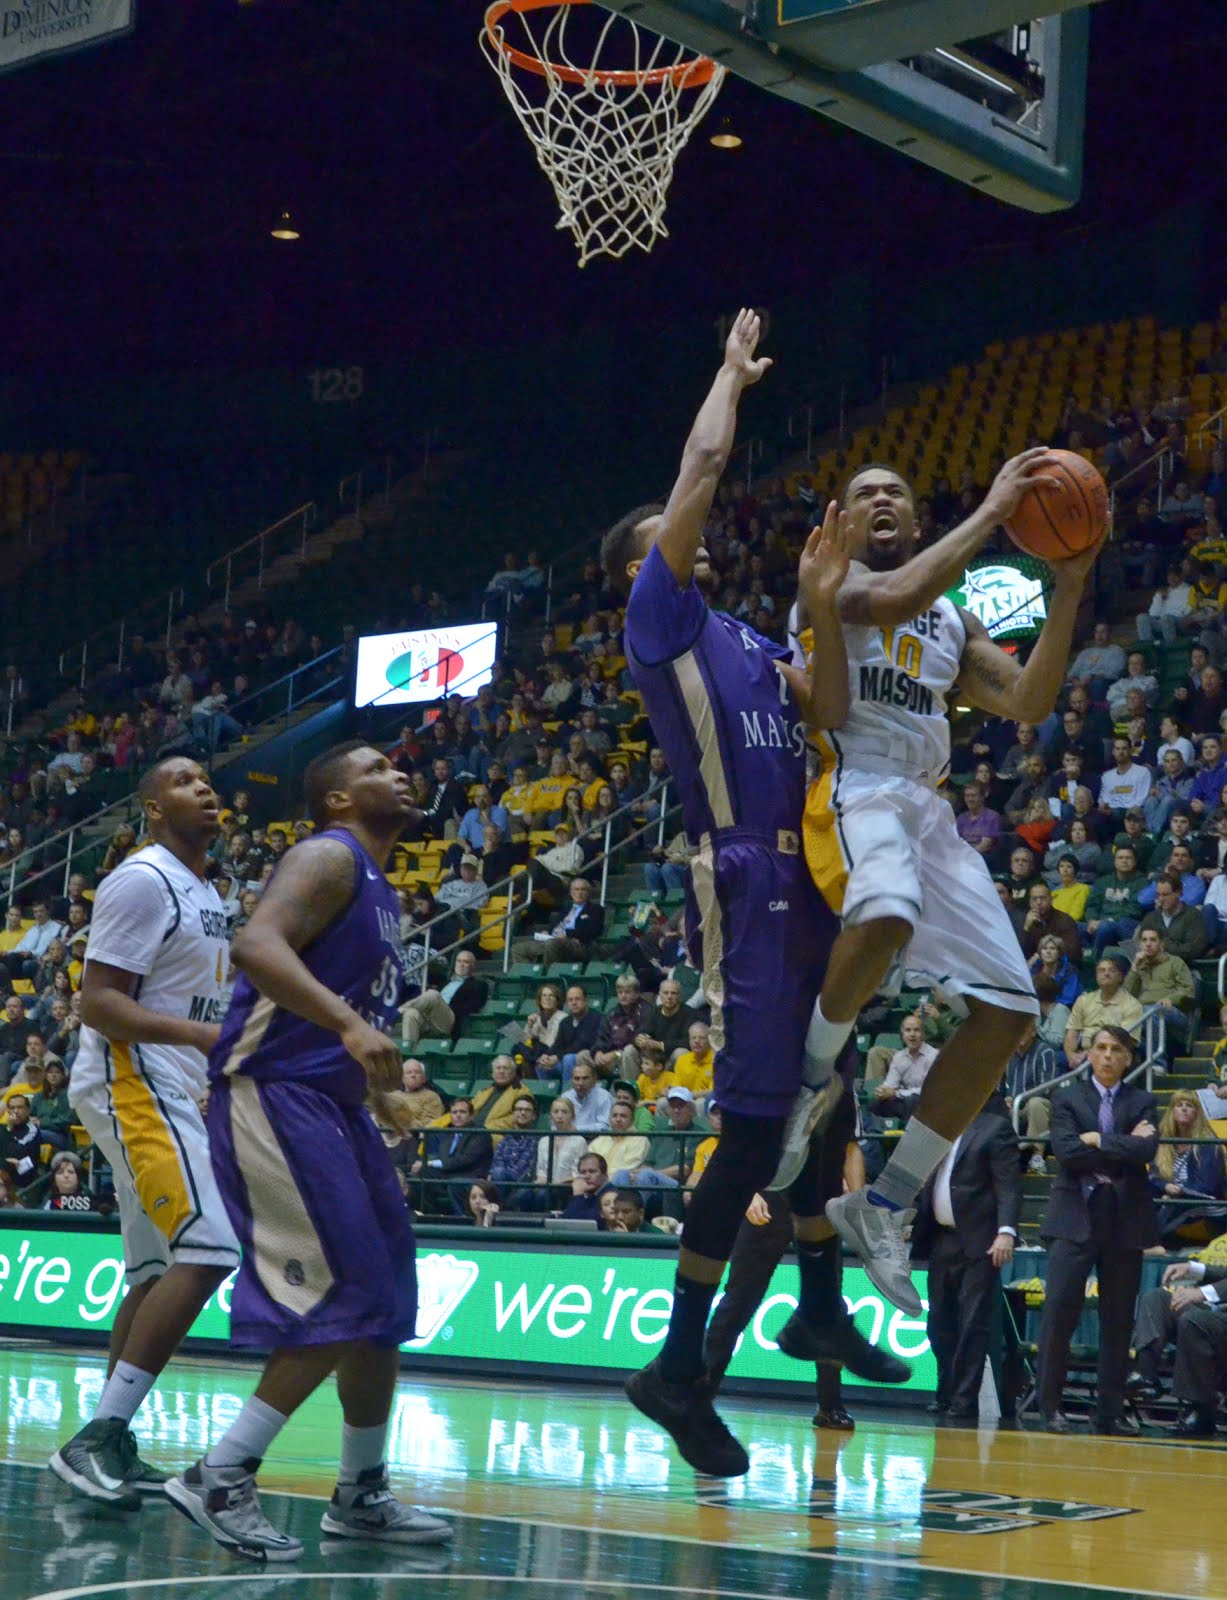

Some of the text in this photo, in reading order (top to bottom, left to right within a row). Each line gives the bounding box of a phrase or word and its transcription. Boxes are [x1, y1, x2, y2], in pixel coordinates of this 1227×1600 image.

[860, 666, 932, 716] MASON
[60, 1195, 91, 1210] POSS
[495, 1268, 675, 1345] we're
